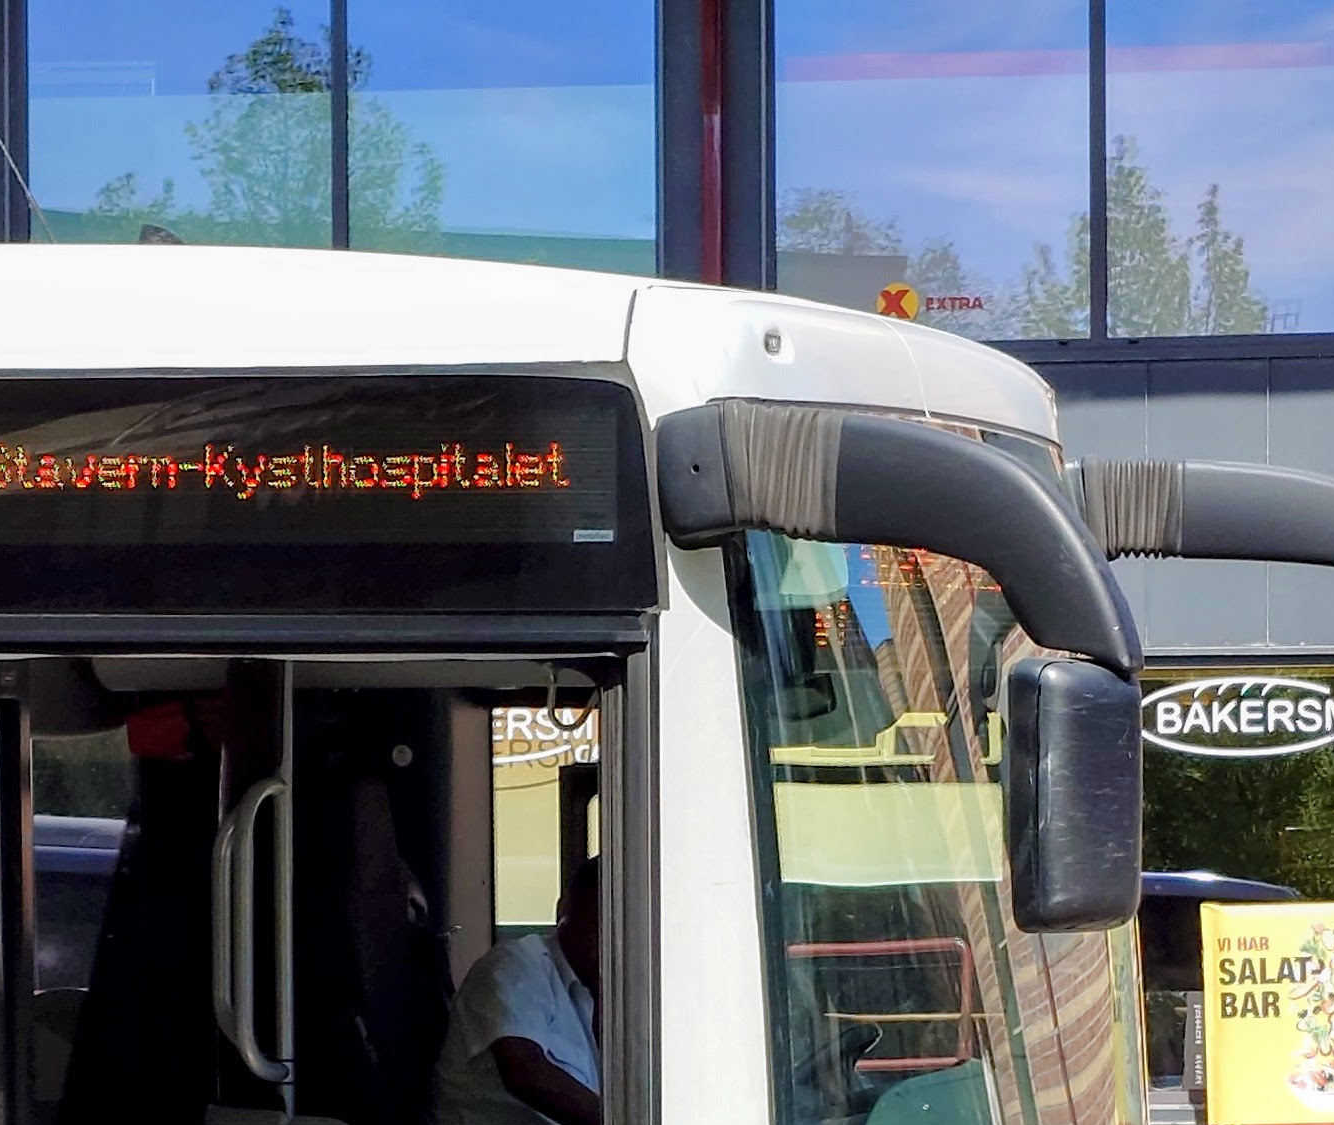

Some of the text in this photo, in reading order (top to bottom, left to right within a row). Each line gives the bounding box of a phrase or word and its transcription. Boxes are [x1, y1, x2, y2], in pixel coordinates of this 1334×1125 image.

[925, 295, 985, 312] EXTRA
[1217, 936, 1269, 953] VI HAR
[1220, 991, 1281, 1019] BAR
